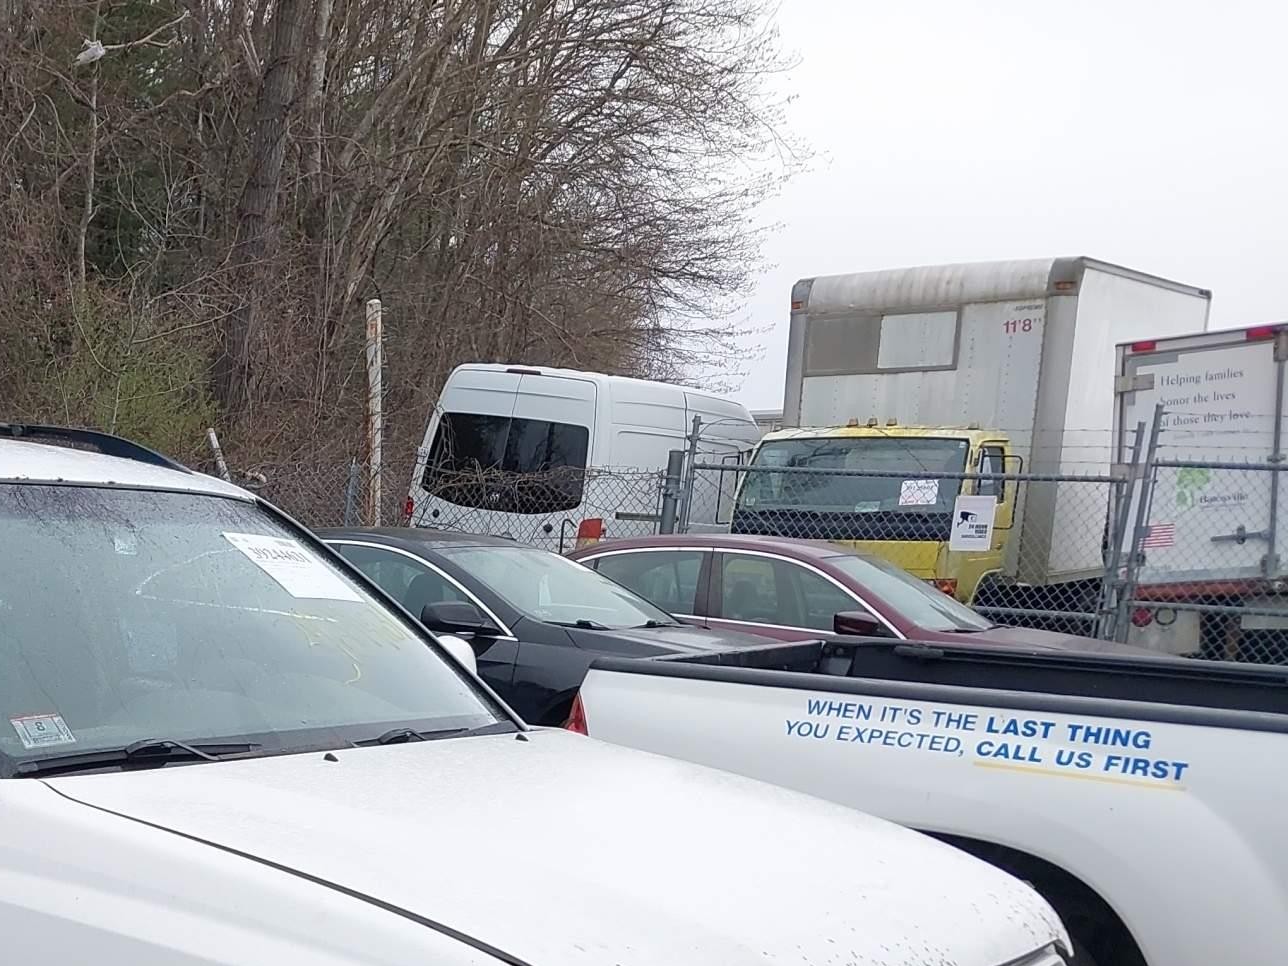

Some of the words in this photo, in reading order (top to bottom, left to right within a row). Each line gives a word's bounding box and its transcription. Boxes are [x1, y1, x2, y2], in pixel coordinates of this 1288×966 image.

[1160, 374, 1201, 387] Helping
[1205, 368, 1244, 381] families
[1193, 392, 1209, 403] the
[1213, 391, 1236, 401] lives
[1173, 415, 1200, 426] those
[1203, 412, 1224, 424] they
[35, 721, 46, 731] 8
[807, 699, 872, 720] WHEN
[880, 705, 922, 726] IT'S
[932, 710, 978, 731] THE
[986, 716, 1056, 739] LAST
[1067, 724, 1152, 749] THING
[785, 720, 829, 739] YOU
[836, 726, 964, 757] EXPECTED,
[976, 741, 1042, 763] CALL
[1055, 749, 1093, 769] US
[1103, 755, 1189, 781] FIRST
